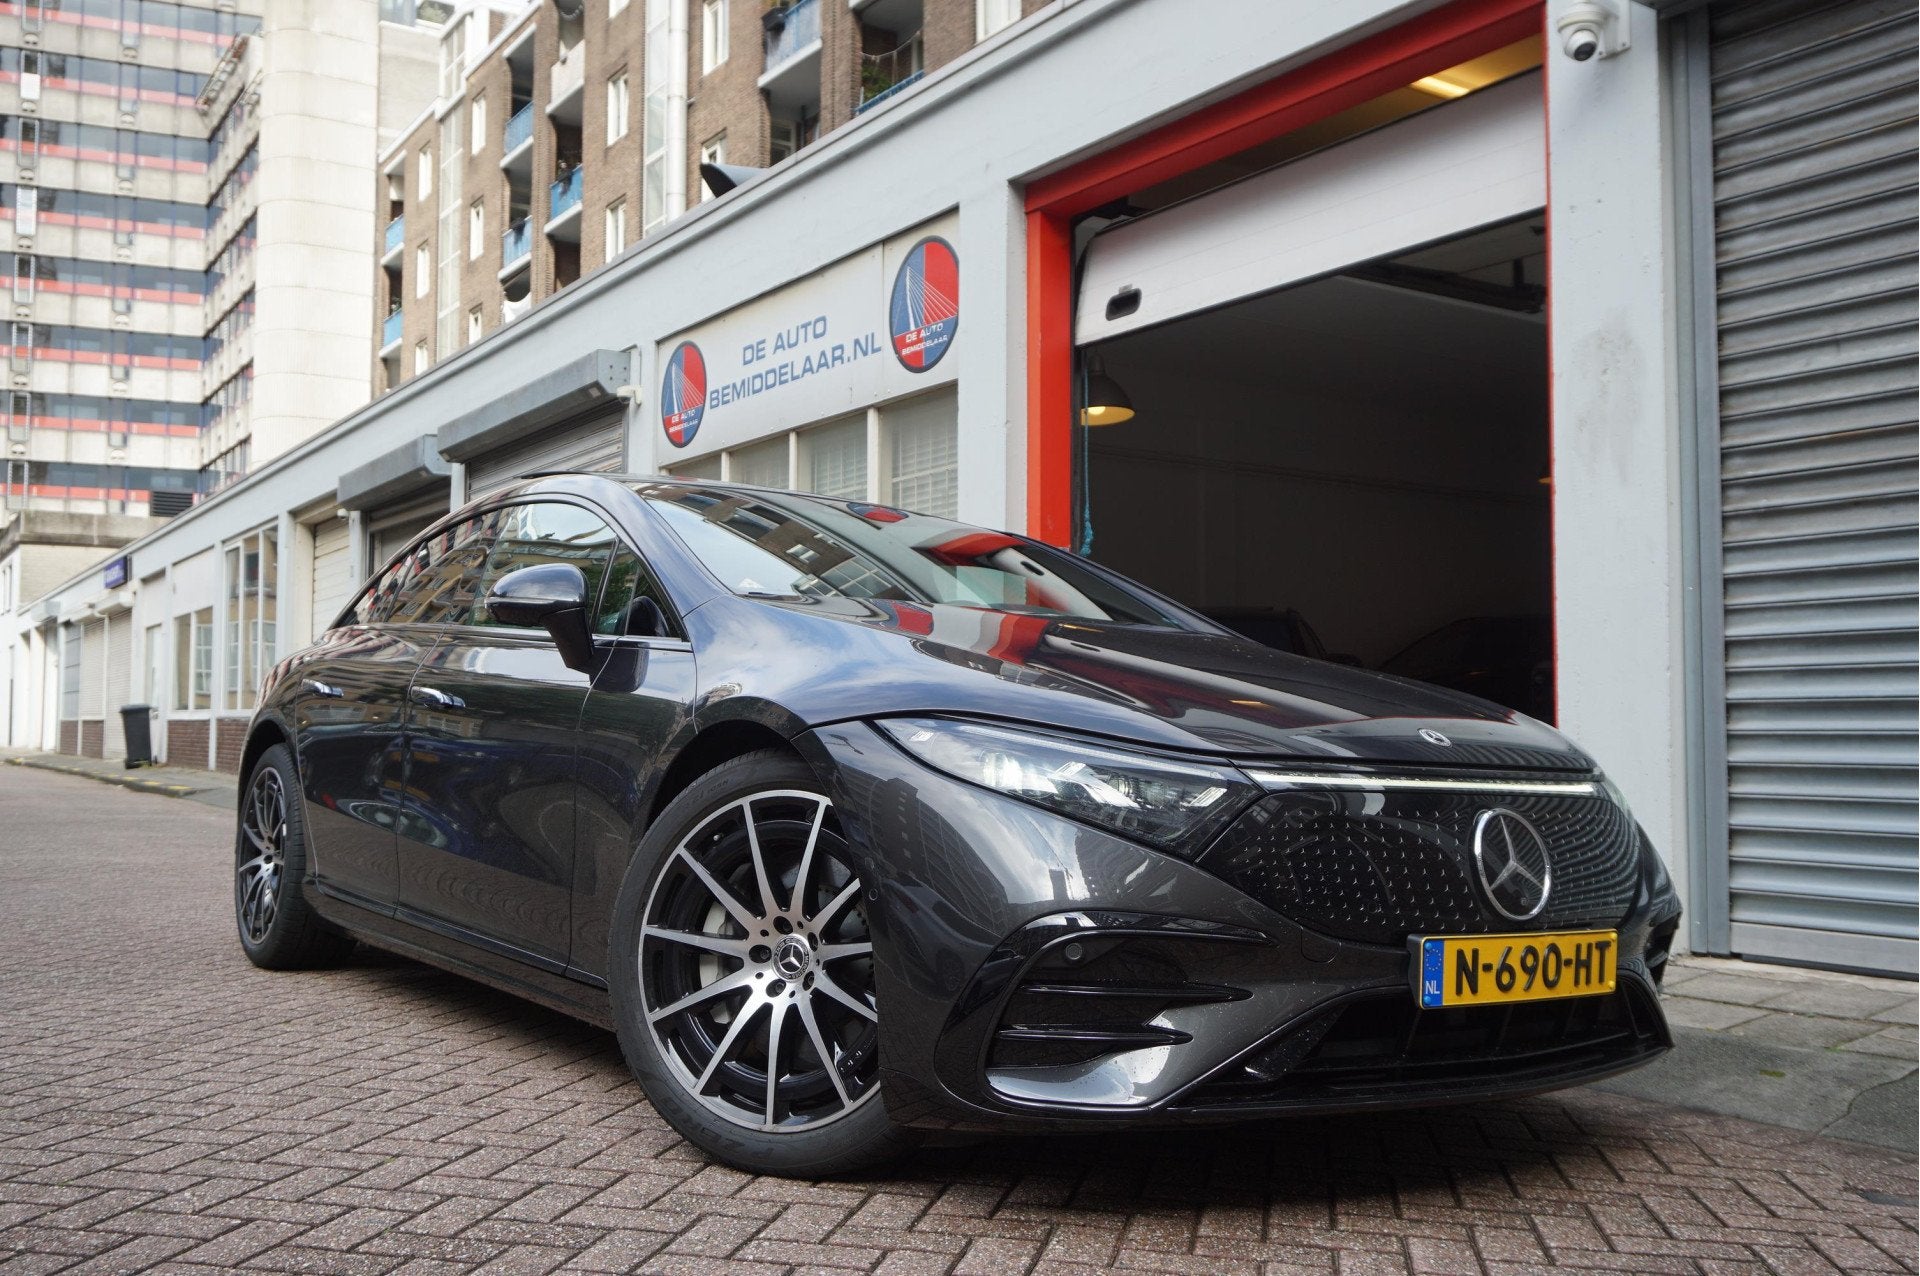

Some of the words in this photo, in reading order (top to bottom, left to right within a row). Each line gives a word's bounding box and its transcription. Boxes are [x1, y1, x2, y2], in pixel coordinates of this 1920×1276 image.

[742, 338, 767, 366] DE
[772, 315, 828, 355] AUTO
[905, 331, 918, 343] DE
[919, 322, 944, 339] AUTO
[709, 332, 882, 410] BEMIDDELAAR.NL
[1425, 980, 1441, 995] NL
[1455, 940, 1612, 997] N-690-HT
